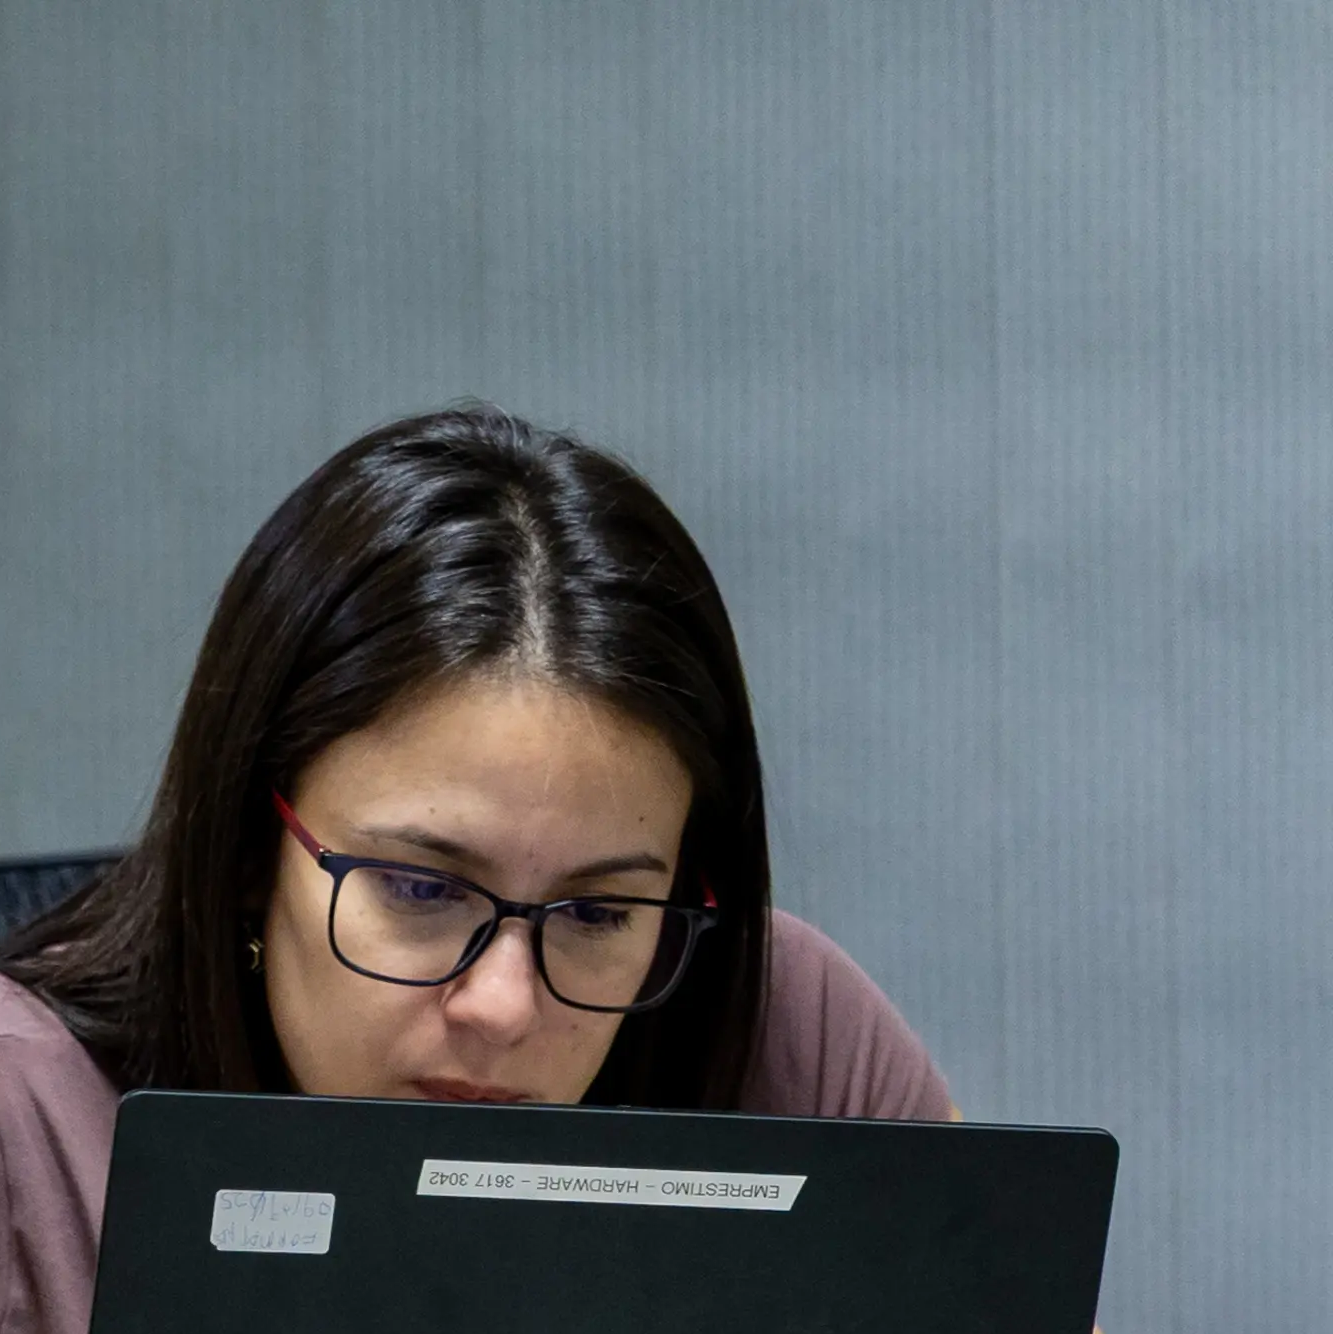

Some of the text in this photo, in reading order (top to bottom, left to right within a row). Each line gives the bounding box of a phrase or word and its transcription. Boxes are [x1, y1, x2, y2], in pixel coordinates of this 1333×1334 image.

[428, 1170, 469, 1187] 3042
[475, 1173, 515, 1189] 3617
[536, 1176, 639, 1194] HARDWARE
[660, 1180, 780, 1199] EMPRESTIMO
